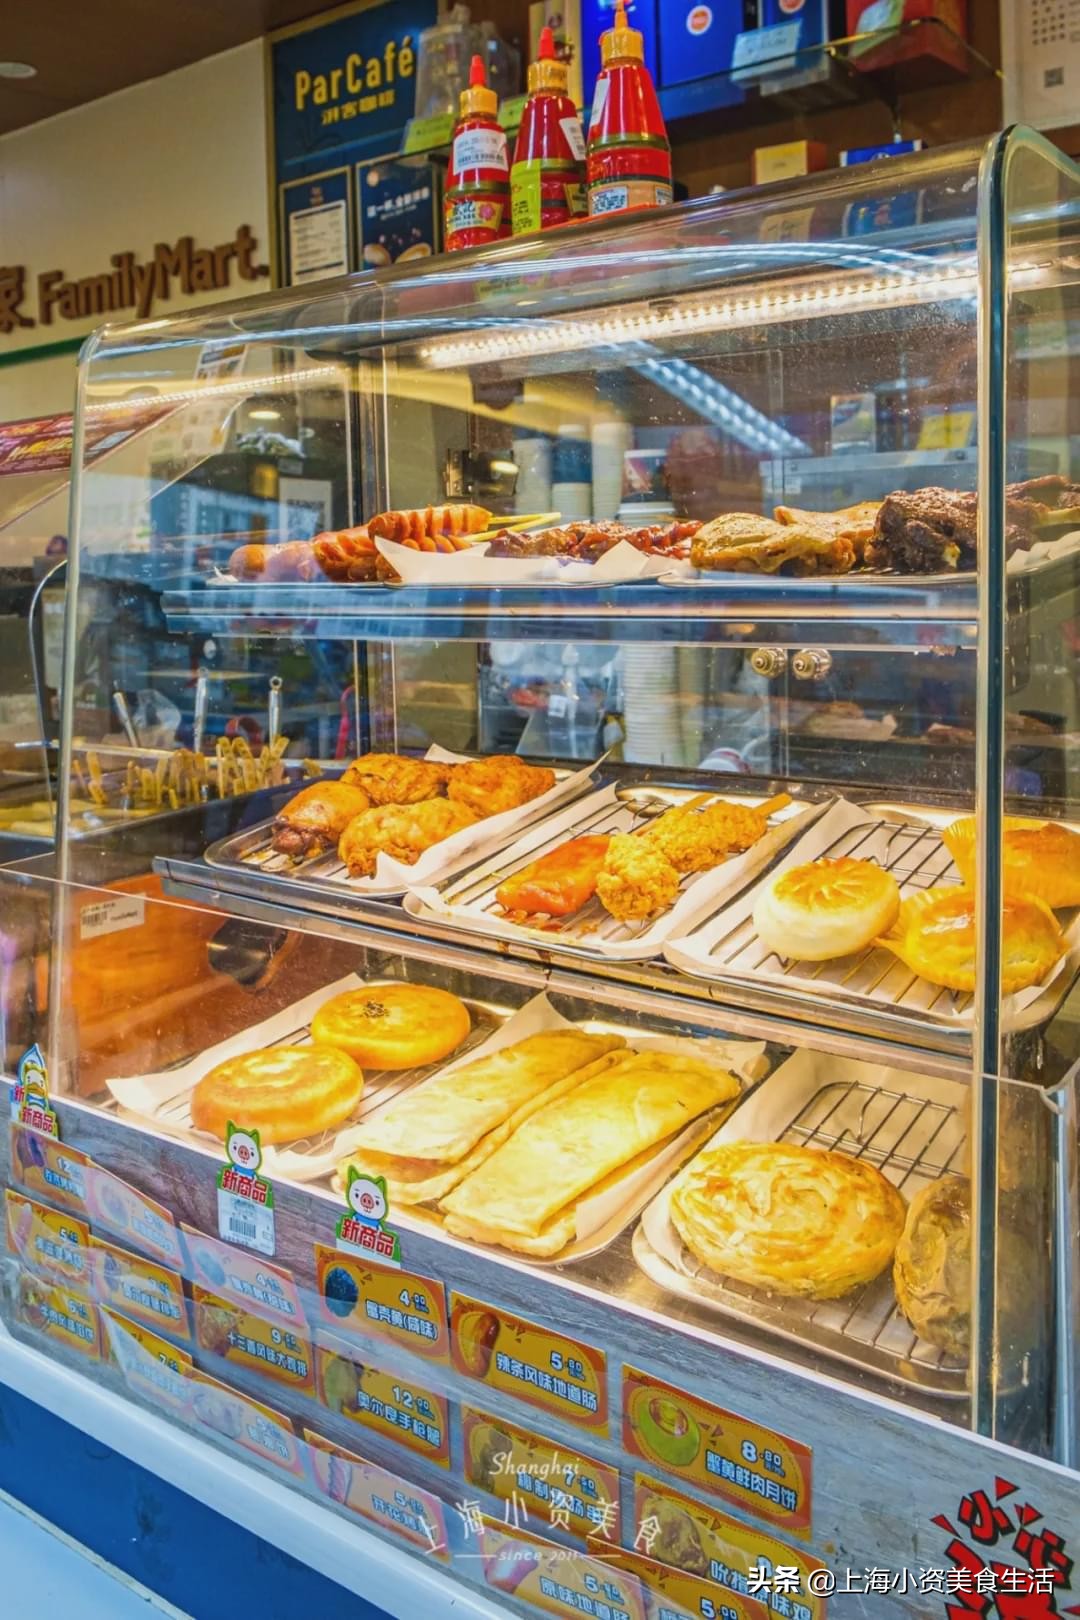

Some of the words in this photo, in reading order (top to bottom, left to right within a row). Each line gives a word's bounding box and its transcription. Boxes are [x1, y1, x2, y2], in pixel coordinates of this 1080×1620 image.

[295, 35, 414, 110] ParCafé
[21, 1106, 54, 1134] 新商品
[221, 1169, 268, 1205] 新商品
[341, 1217, 396, 1258] 新商品
[497, 1353, 598, 1412] 辣条风味地道肠
[741, 1440, 782, 1466] 8.80
[706, 1450, 797, 1511] 蟹黄鲜肉月饼
